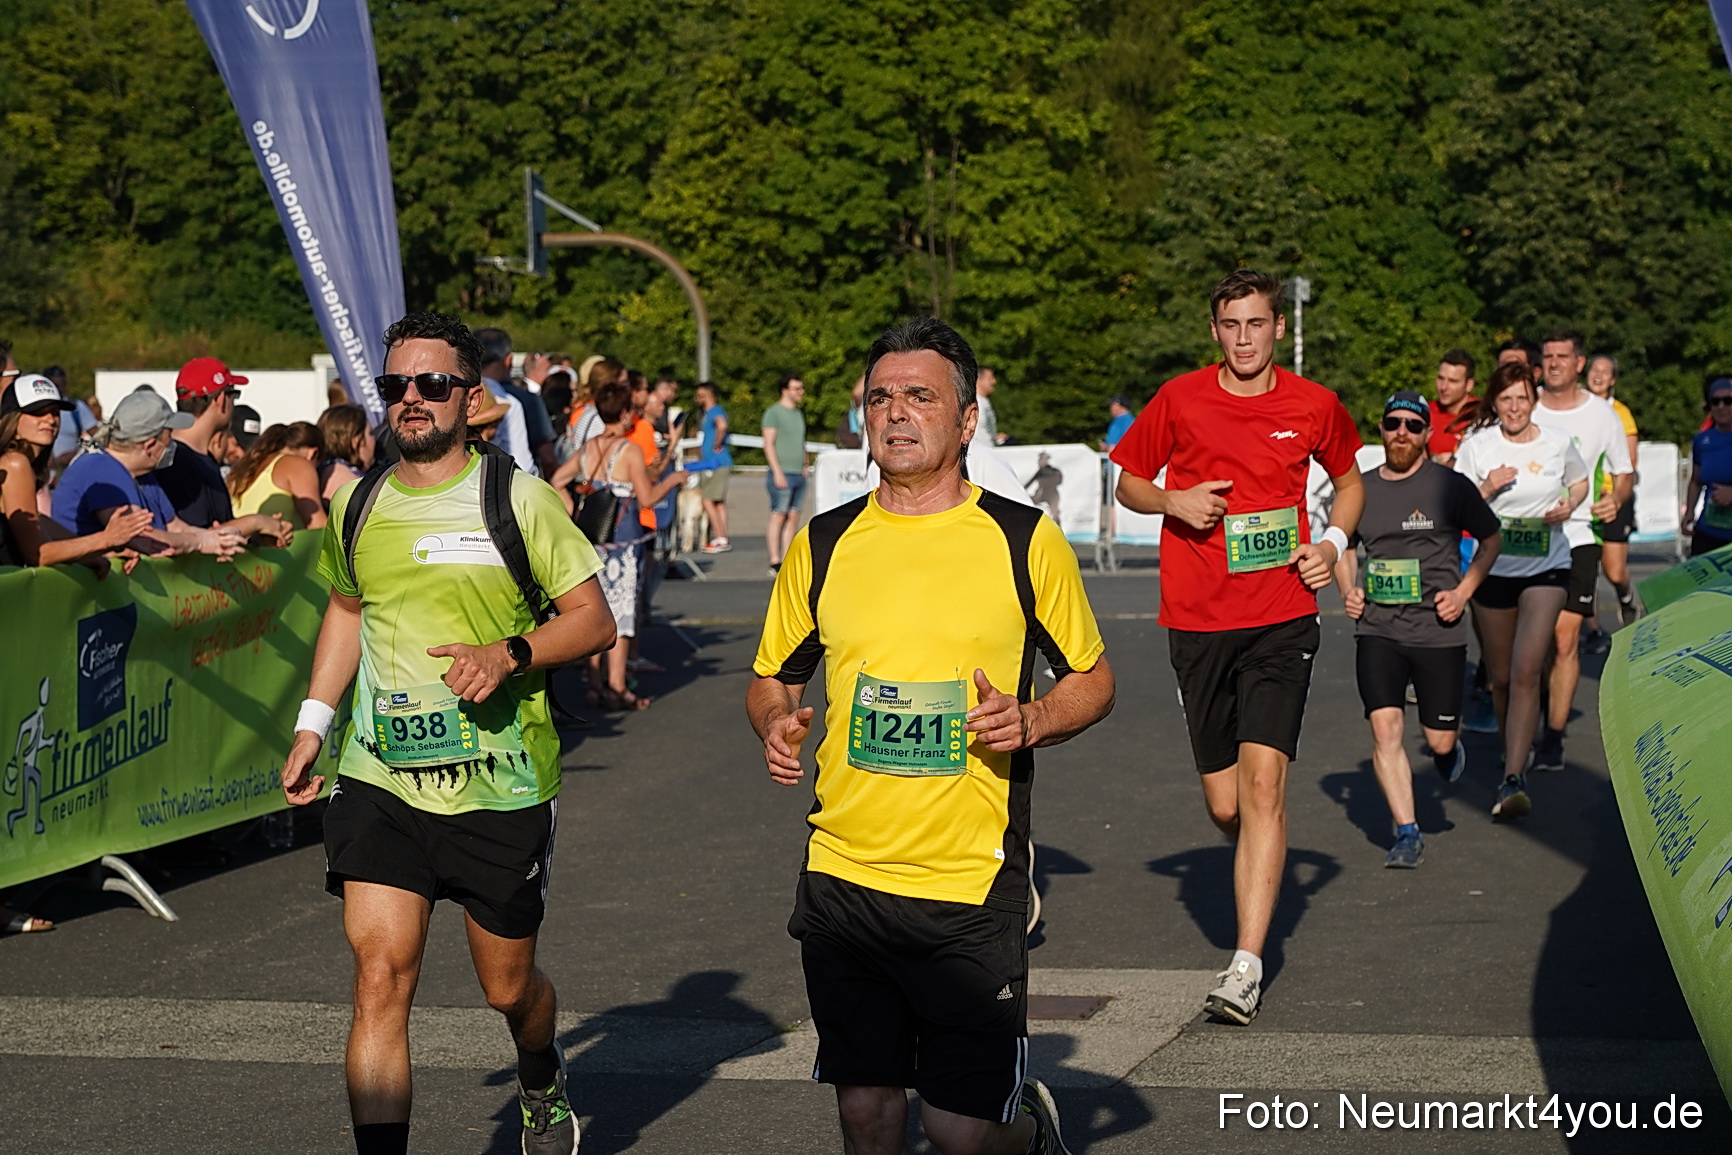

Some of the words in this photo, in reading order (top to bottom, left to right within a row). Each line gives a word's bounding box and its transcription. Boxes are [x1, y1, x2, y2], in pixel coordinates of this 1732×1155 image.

[1240, 529, 1289, 552] 1689
[1505, 530, 1541, 543] 1264
[1240, 550, 1278, 561] Ochsenkühn
[1375, 575, 1404, 589] 941
[88, 642, 124, 671] Fischer
[388, 700, 422, 711] Firmenlauf
[874, 697, 913, 705] Firmenlauf
[52, 677, 173, 797] firmenlauf
[377, 724, 389, 751] RUN
[391, 712, 447, 742] 938
[457, 712, 473, 750] 2022
[853, 716, 863, 749] RUN
[865, 710, 943, 745] 1241
[949, 718, 961, 761] 2022
[386, 743, 416, 754] Schöps
[417, 738, 463, 751] Sebastian
[863, 742, 910, 758] Hausner
[912, 747, 946, 758] Franz
[52, 780, 109, 823] neumarkt
[997, 992, 1013, 1000] adidas
